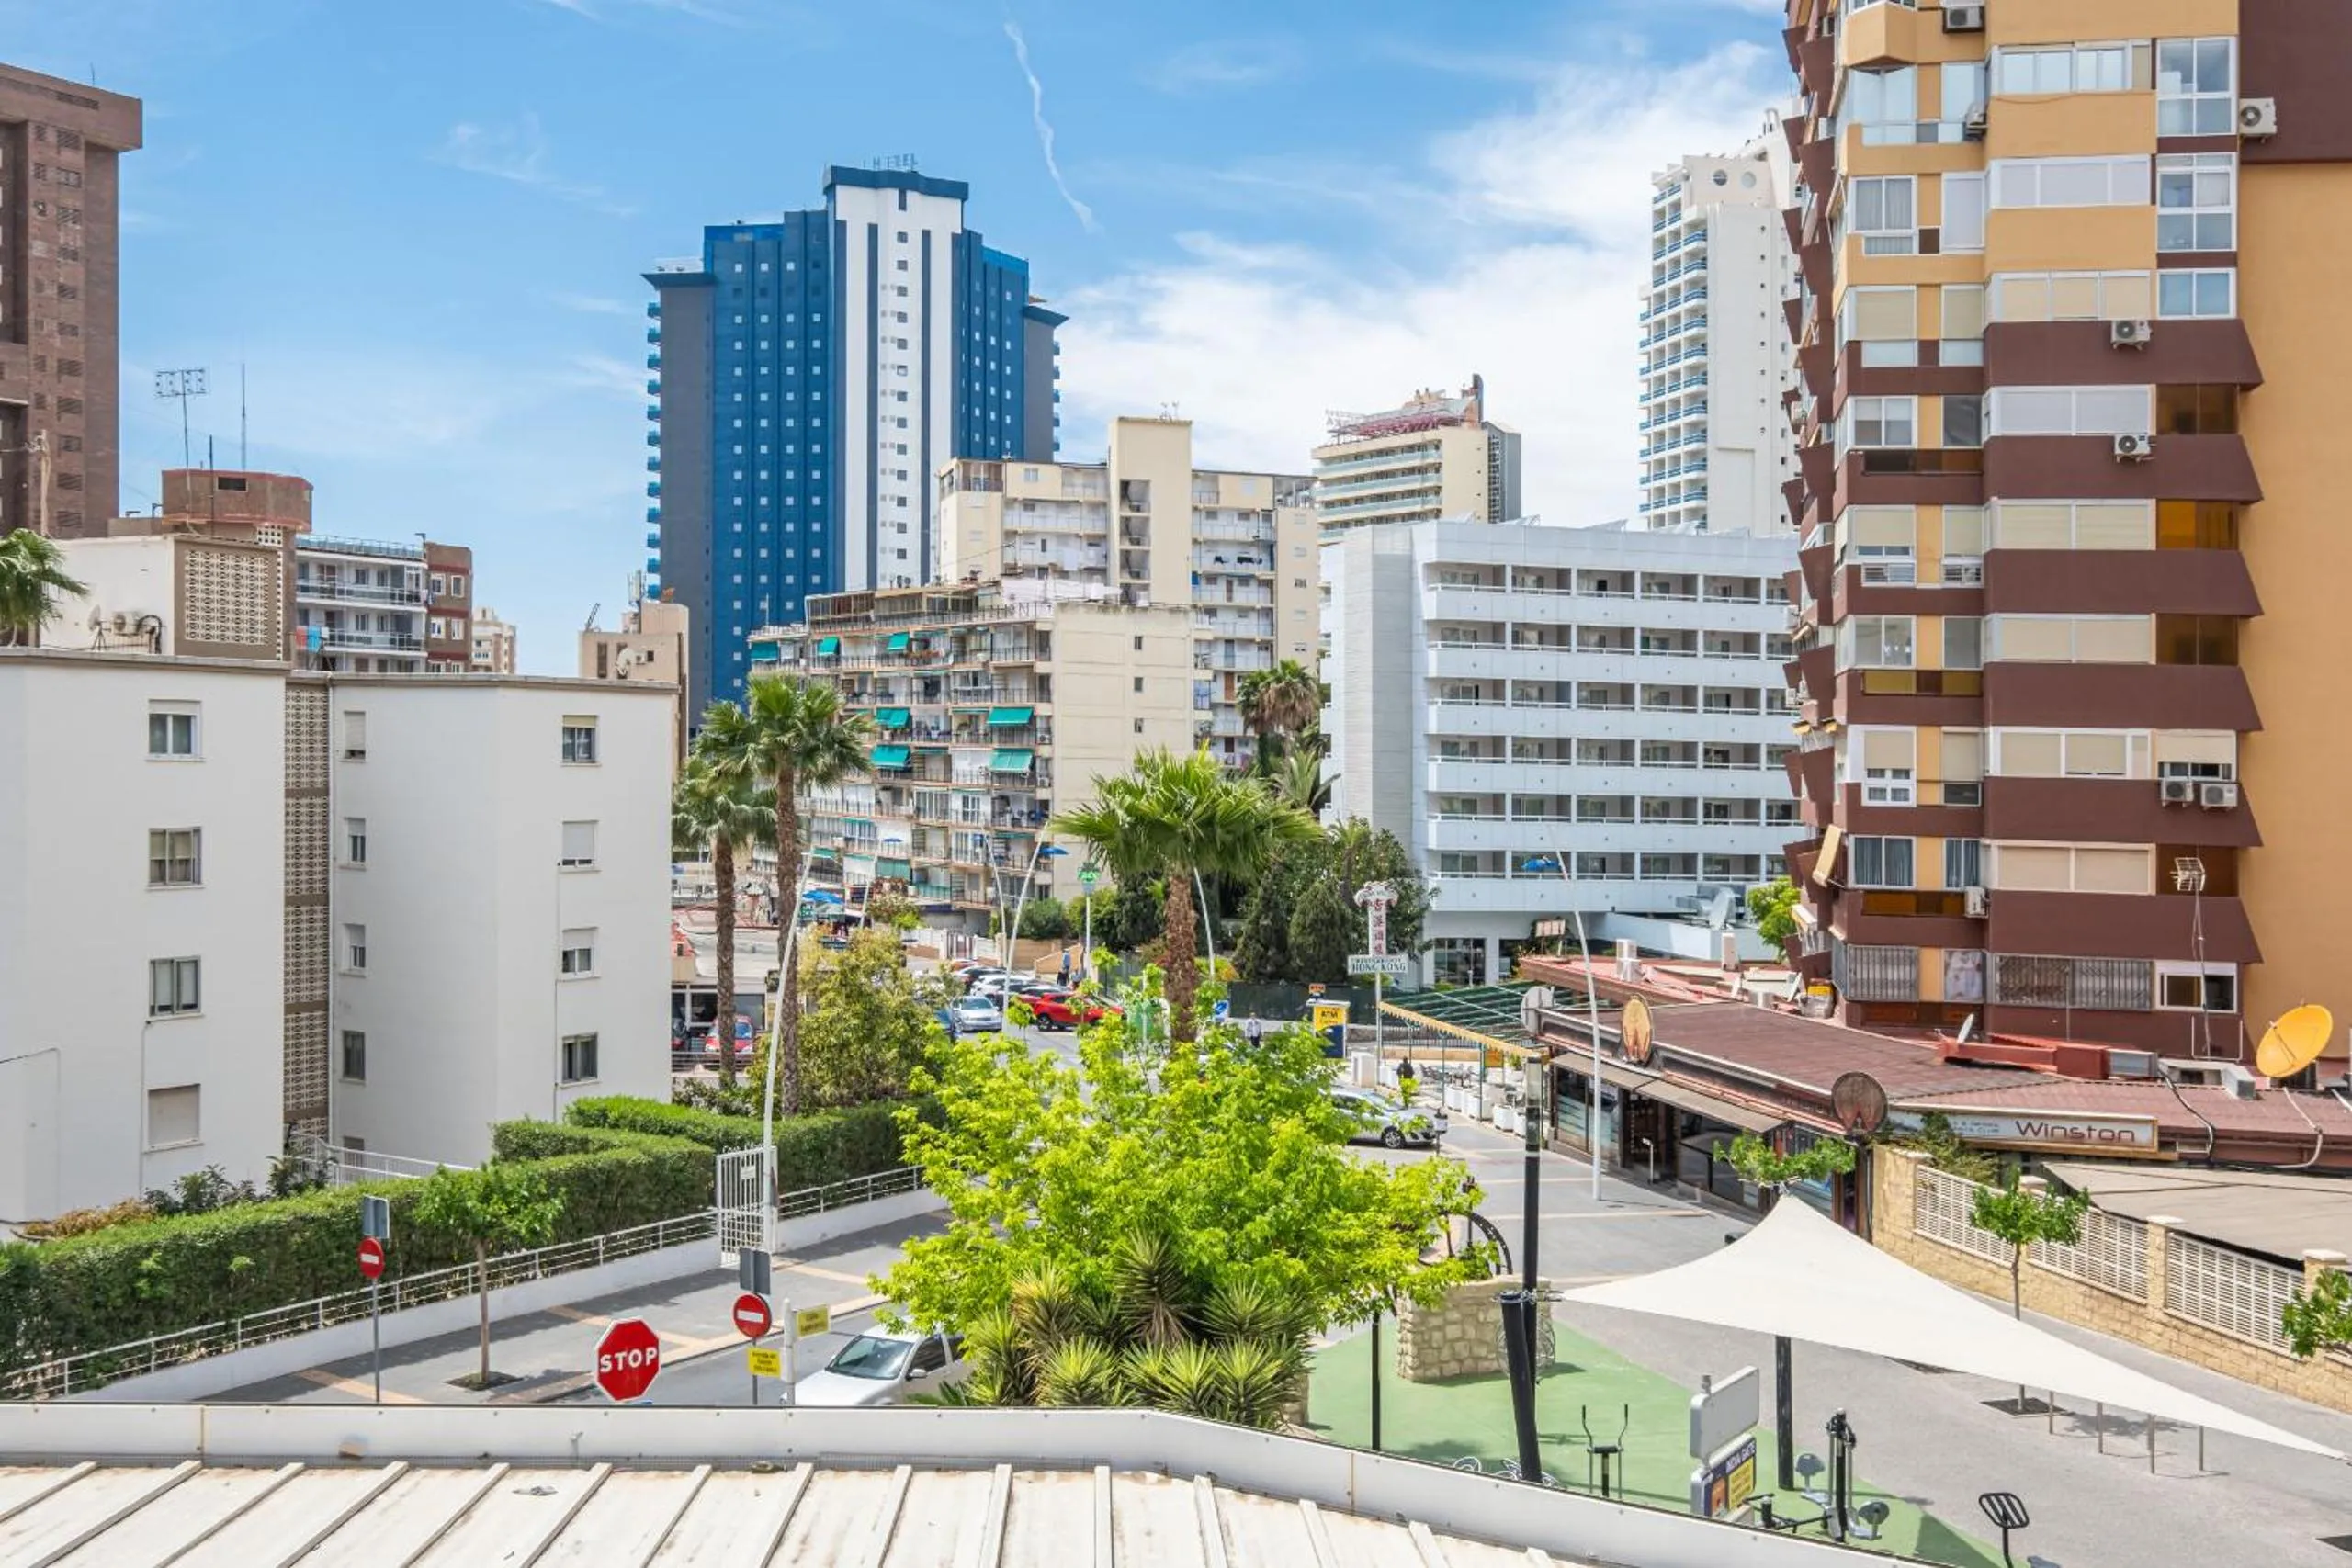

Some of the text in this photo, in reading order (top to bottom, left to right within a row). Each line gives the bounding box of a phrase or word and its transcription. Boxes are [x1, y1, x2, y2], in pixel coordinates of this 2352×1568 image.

[1352, 962, 1406, 972] HONG KONG
[1321, 1010, 1339, 1019] ATM
[2015, 1120, 2135, 1142] Winston
[600, 1347, 658, 1373] STOP
